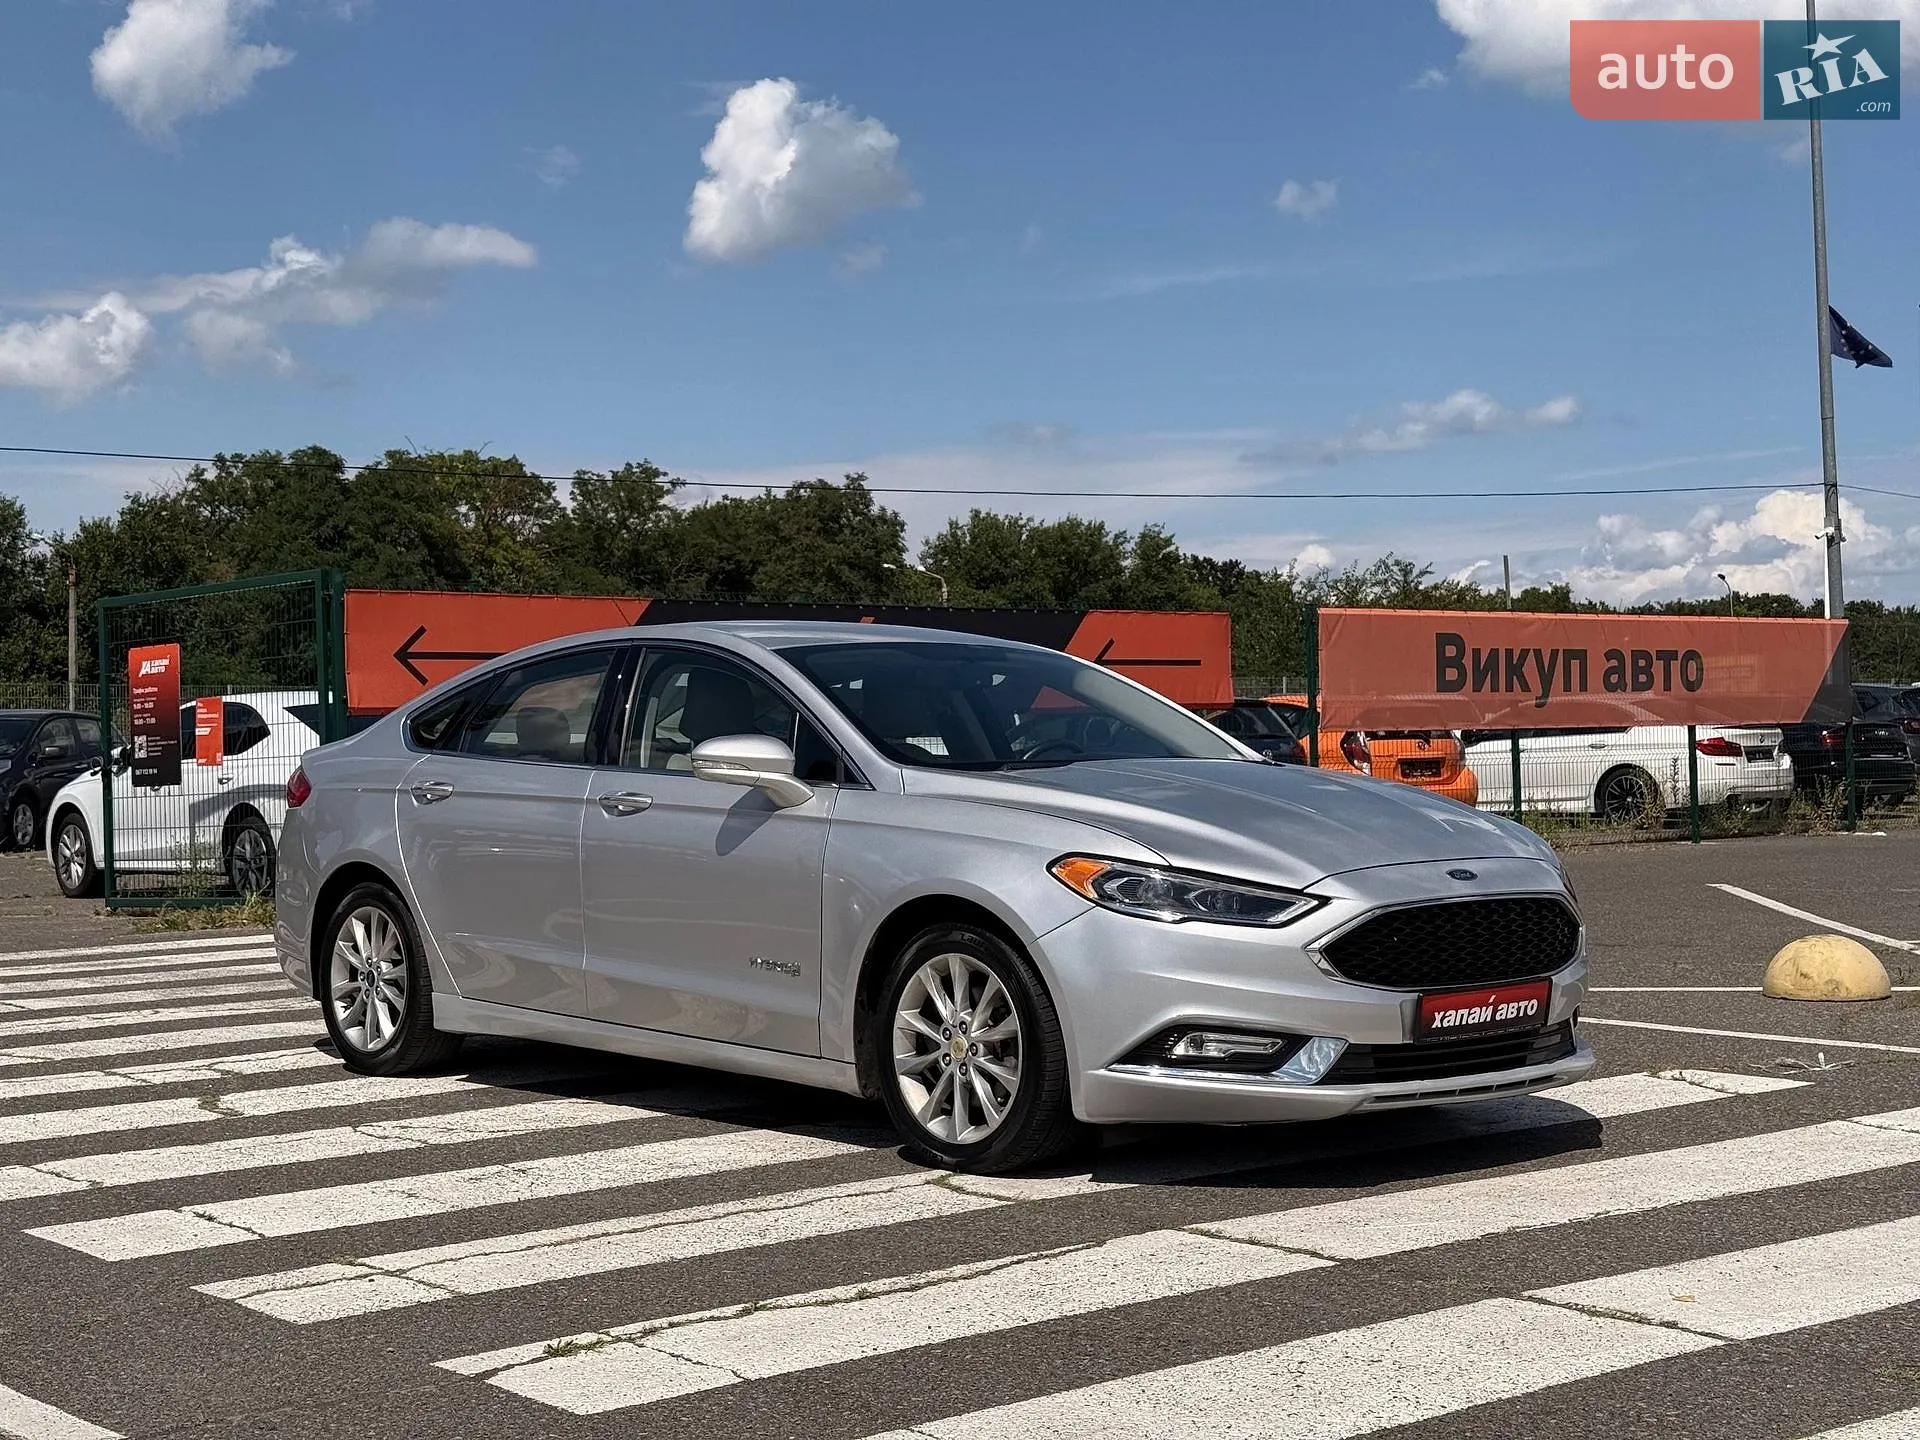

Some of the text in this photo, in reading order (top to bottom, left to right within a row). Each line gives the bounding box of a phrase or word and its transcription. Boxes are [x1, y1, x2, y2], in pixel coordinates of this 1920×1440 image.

[1435, 632, 1705, 709] Викуп авто
[1495, 998, 1538, 1021] авто
